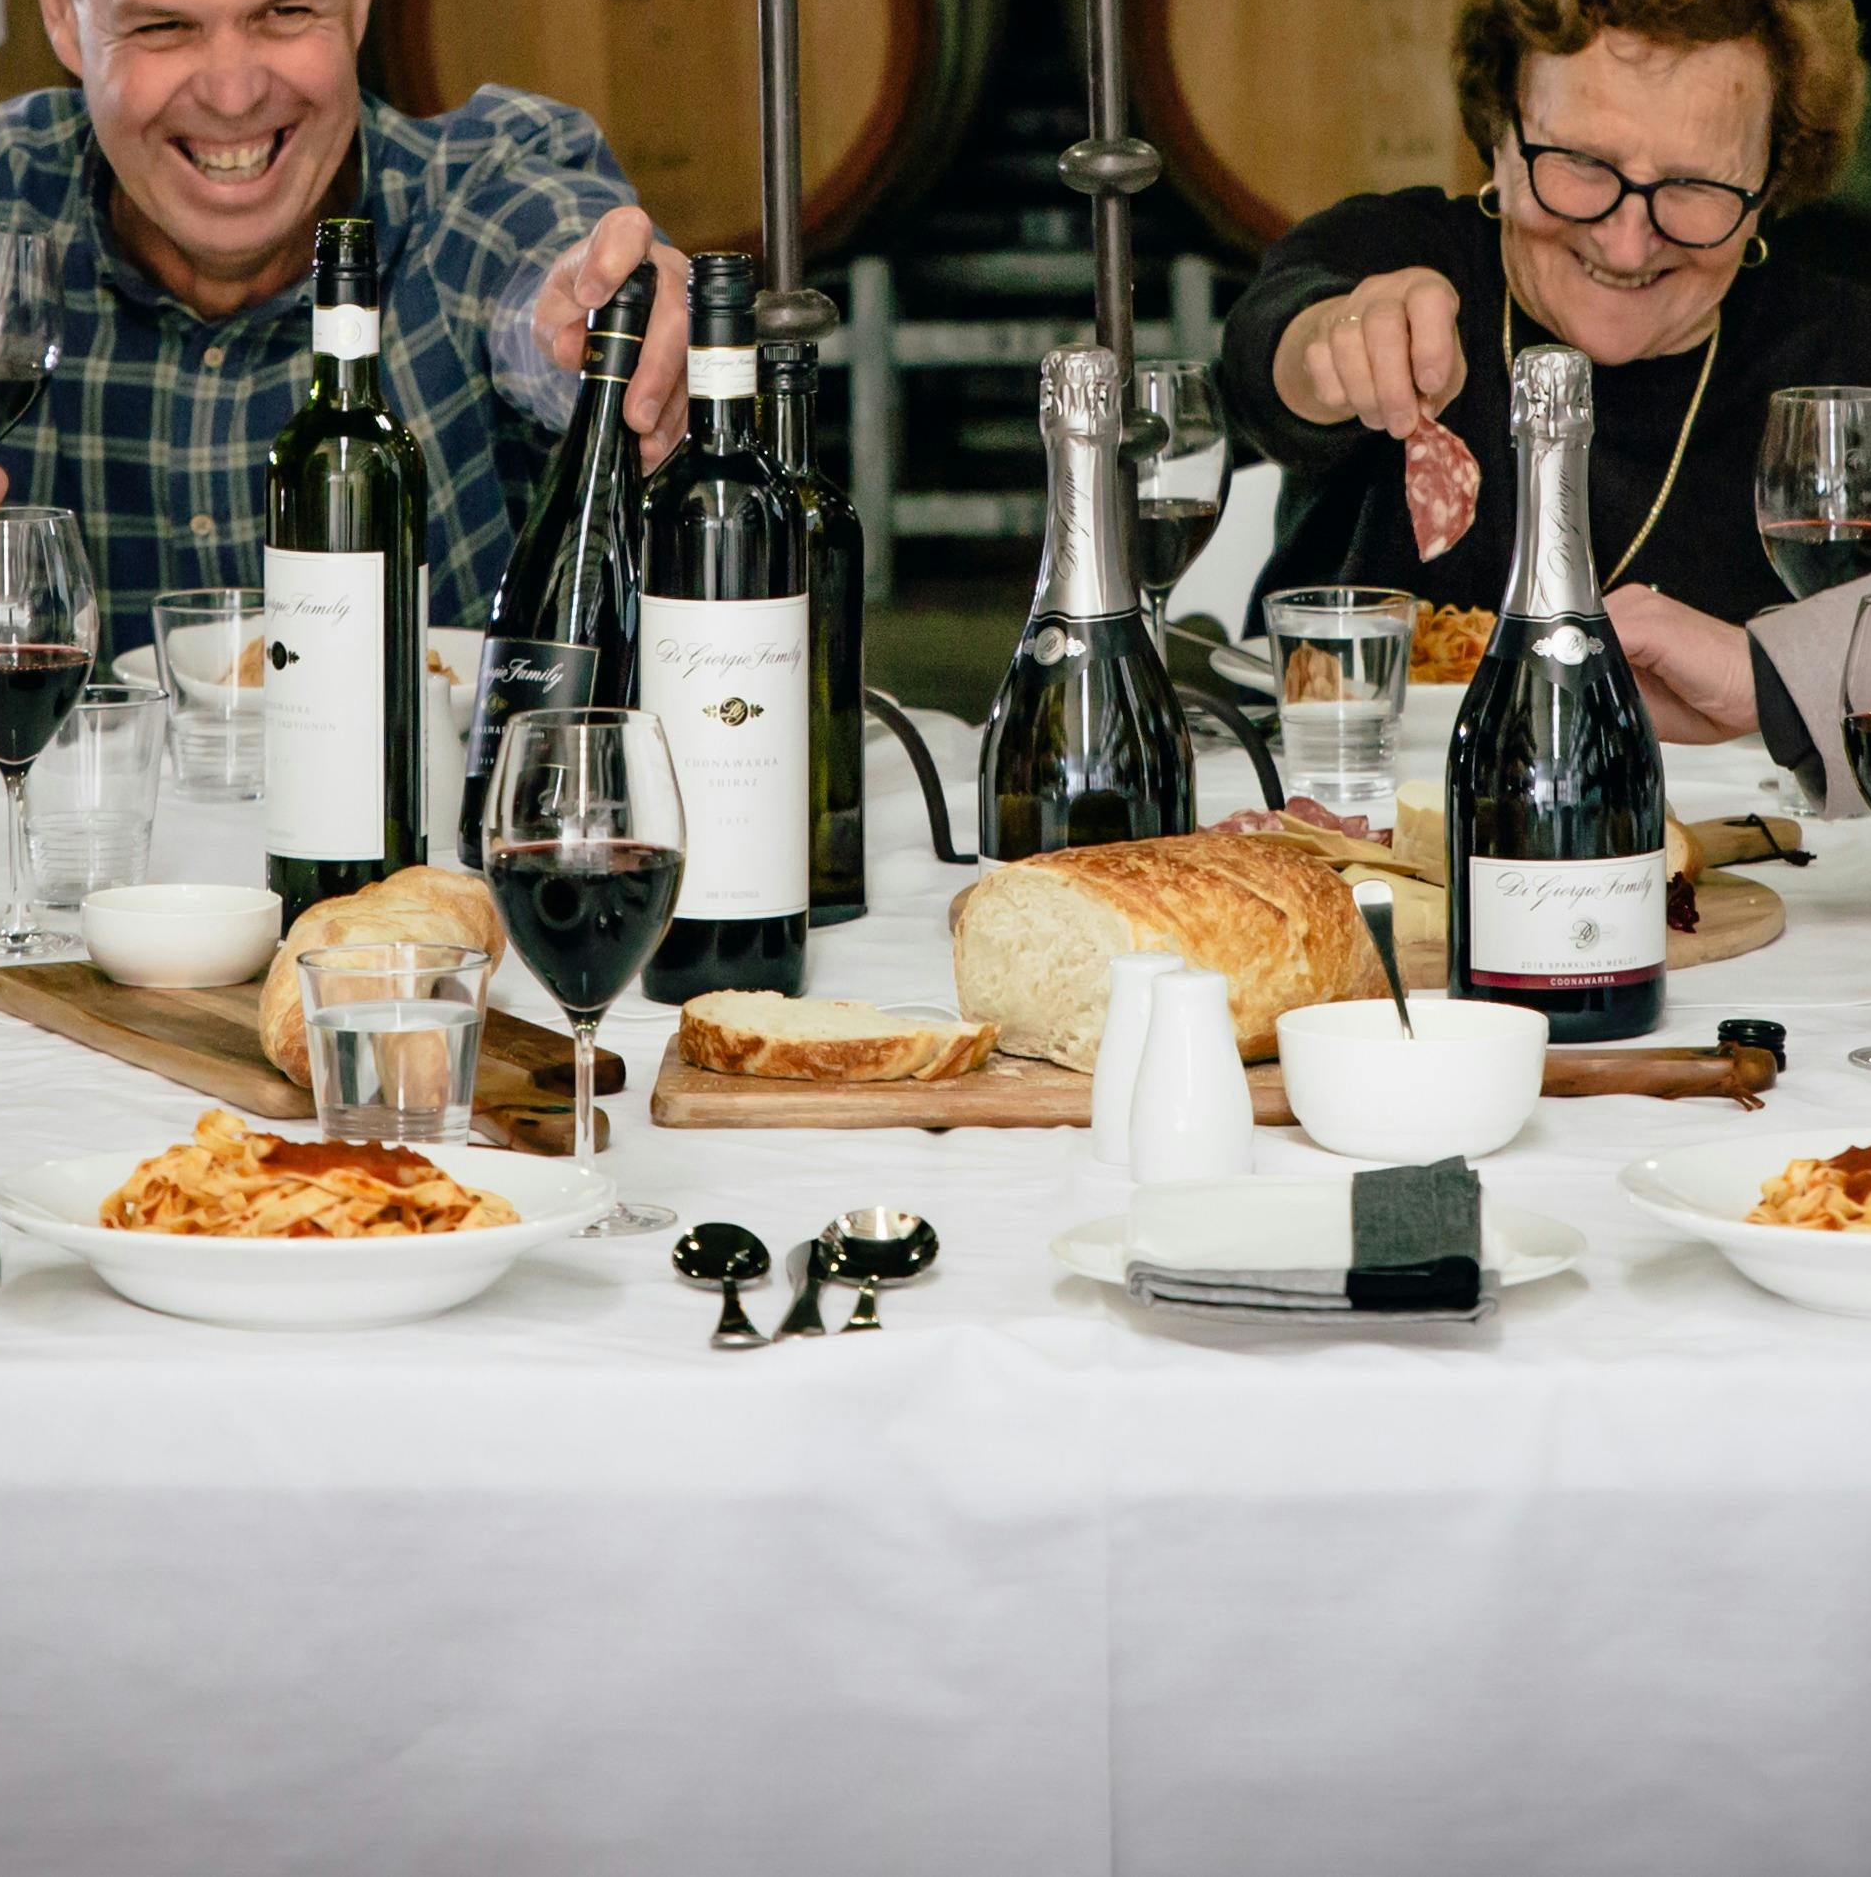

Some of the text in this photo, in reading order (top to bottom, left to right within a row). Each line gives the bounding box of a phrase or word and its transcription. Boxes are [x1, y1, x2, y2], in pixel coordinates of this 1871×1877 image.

[284, 592, 351, 628] Family
[656, 638, 802, 679] Di Giorgio Family
[502, 659, 564, 694] Family
[708, 778, 759, 788] SHIRAZ
[1496, 867, 1653, 912] Di Giorgio Family
[1549, 960, 1602, 970] SPARKLING
[1606, 955, 1638, 967] MERLOT
[1550, 976, 1616, 987] COONAWARRA
